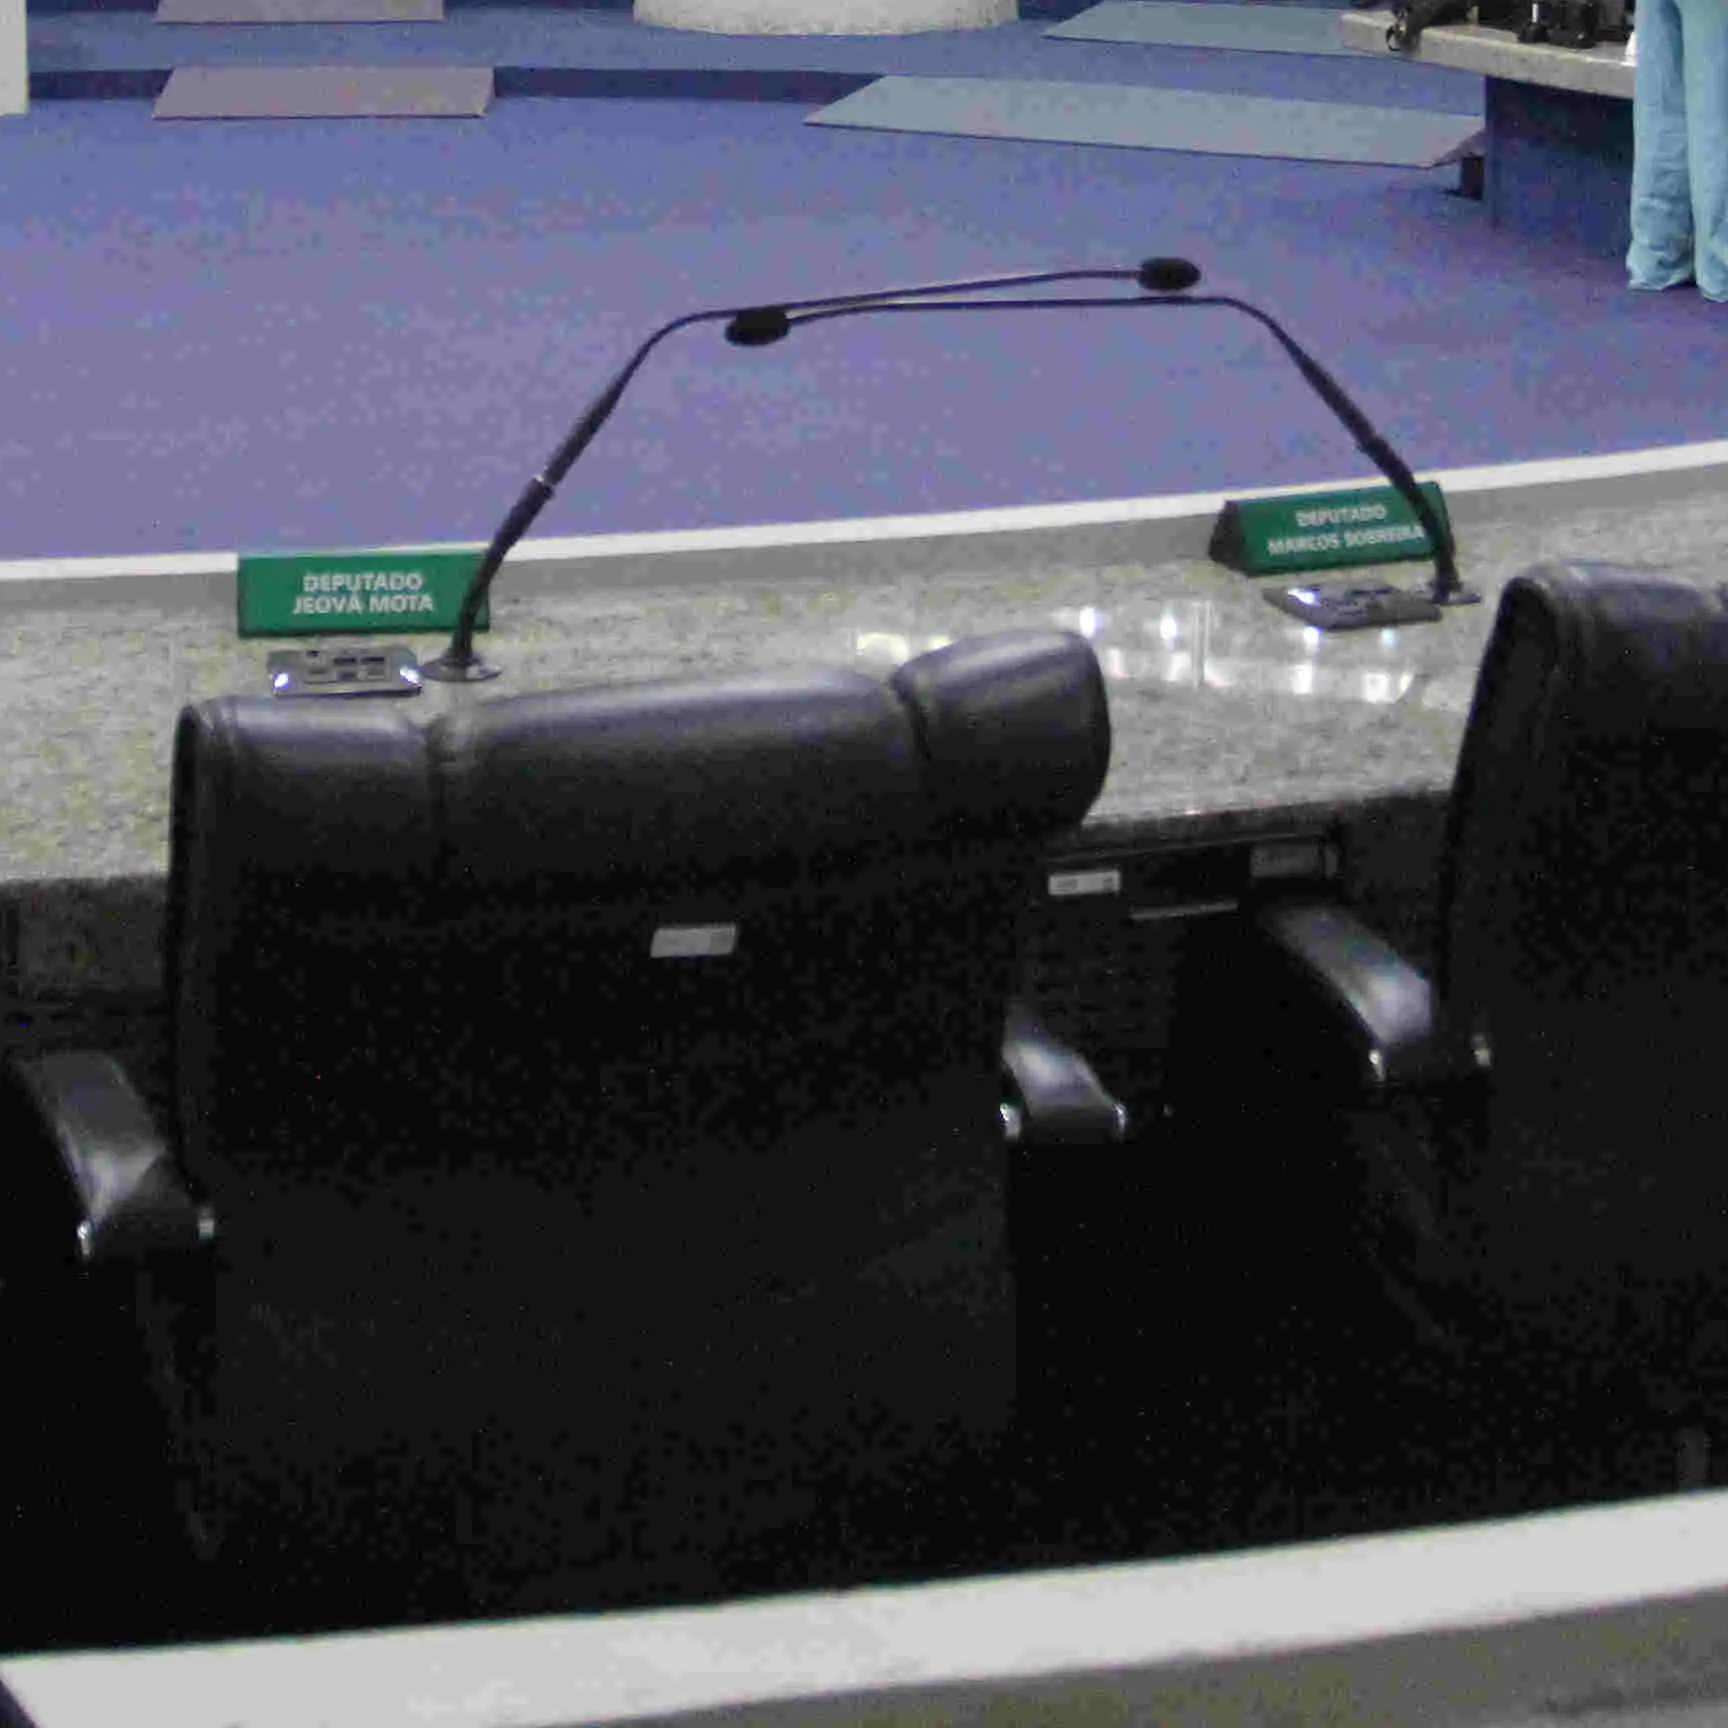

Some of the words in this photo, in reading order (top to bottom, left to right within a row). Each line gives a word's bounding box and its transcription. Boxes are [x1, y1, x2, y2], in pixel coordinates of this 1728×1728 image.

[1295, 504, 1389, 527] DEPUTADO
[302, 572, 424, 594] DEPUTADO
[369, 595, 433, 614] MOTA
